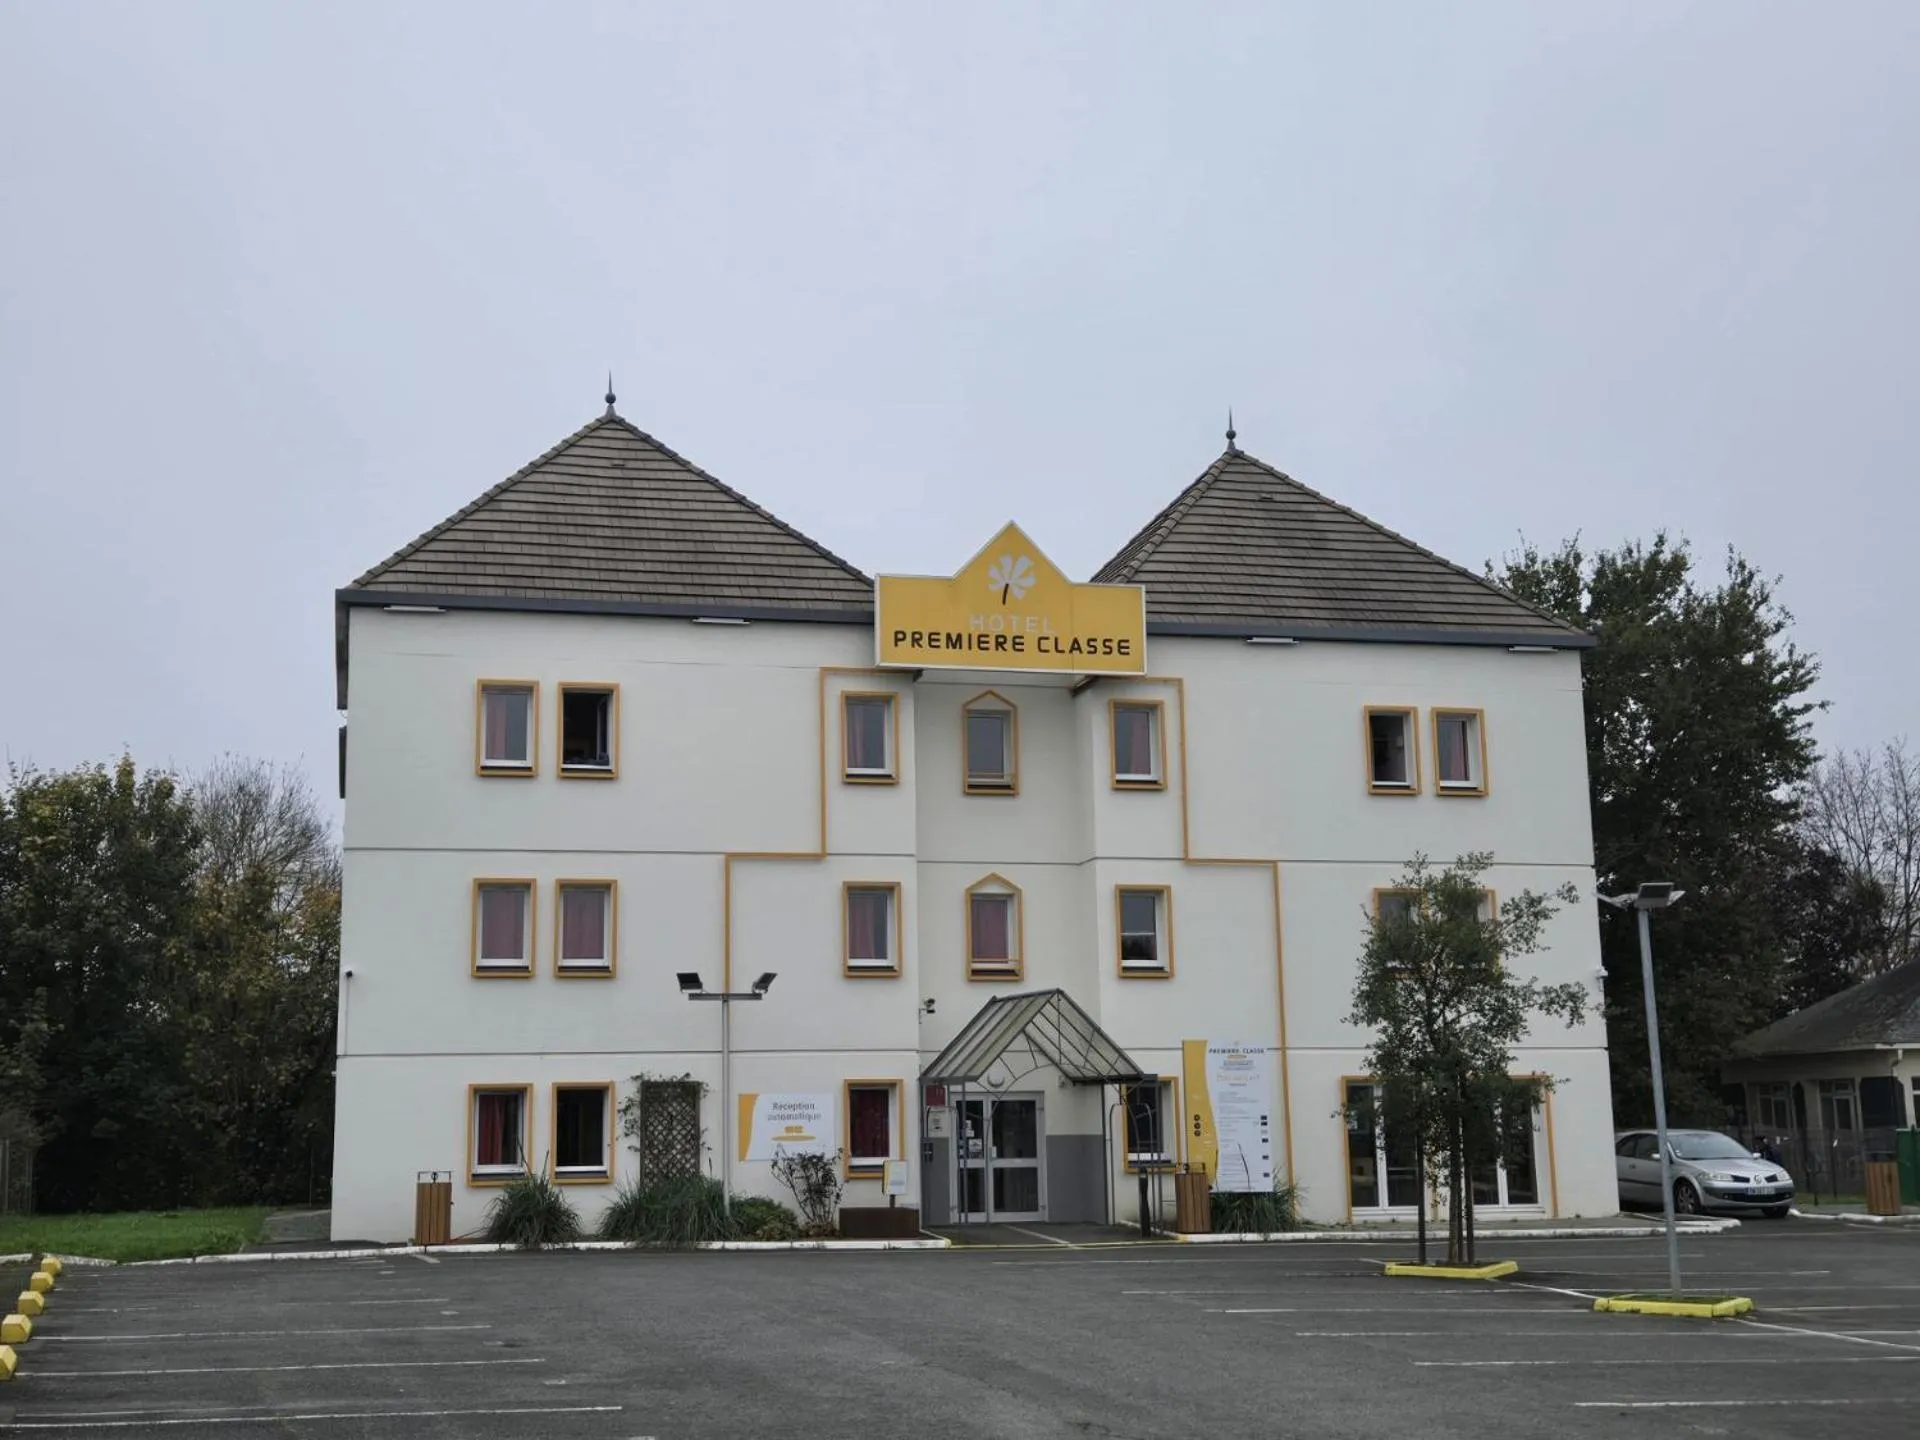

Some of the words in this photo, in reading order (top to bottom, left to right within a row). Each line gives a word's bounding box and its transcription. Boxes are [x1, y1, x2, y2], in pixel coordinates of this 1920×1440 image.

[969, 613, 1055, 635] HOTEL
[893, 630, 1025, 652] PREMIERE
[1036, 636, 1131, 656] CLASSE
